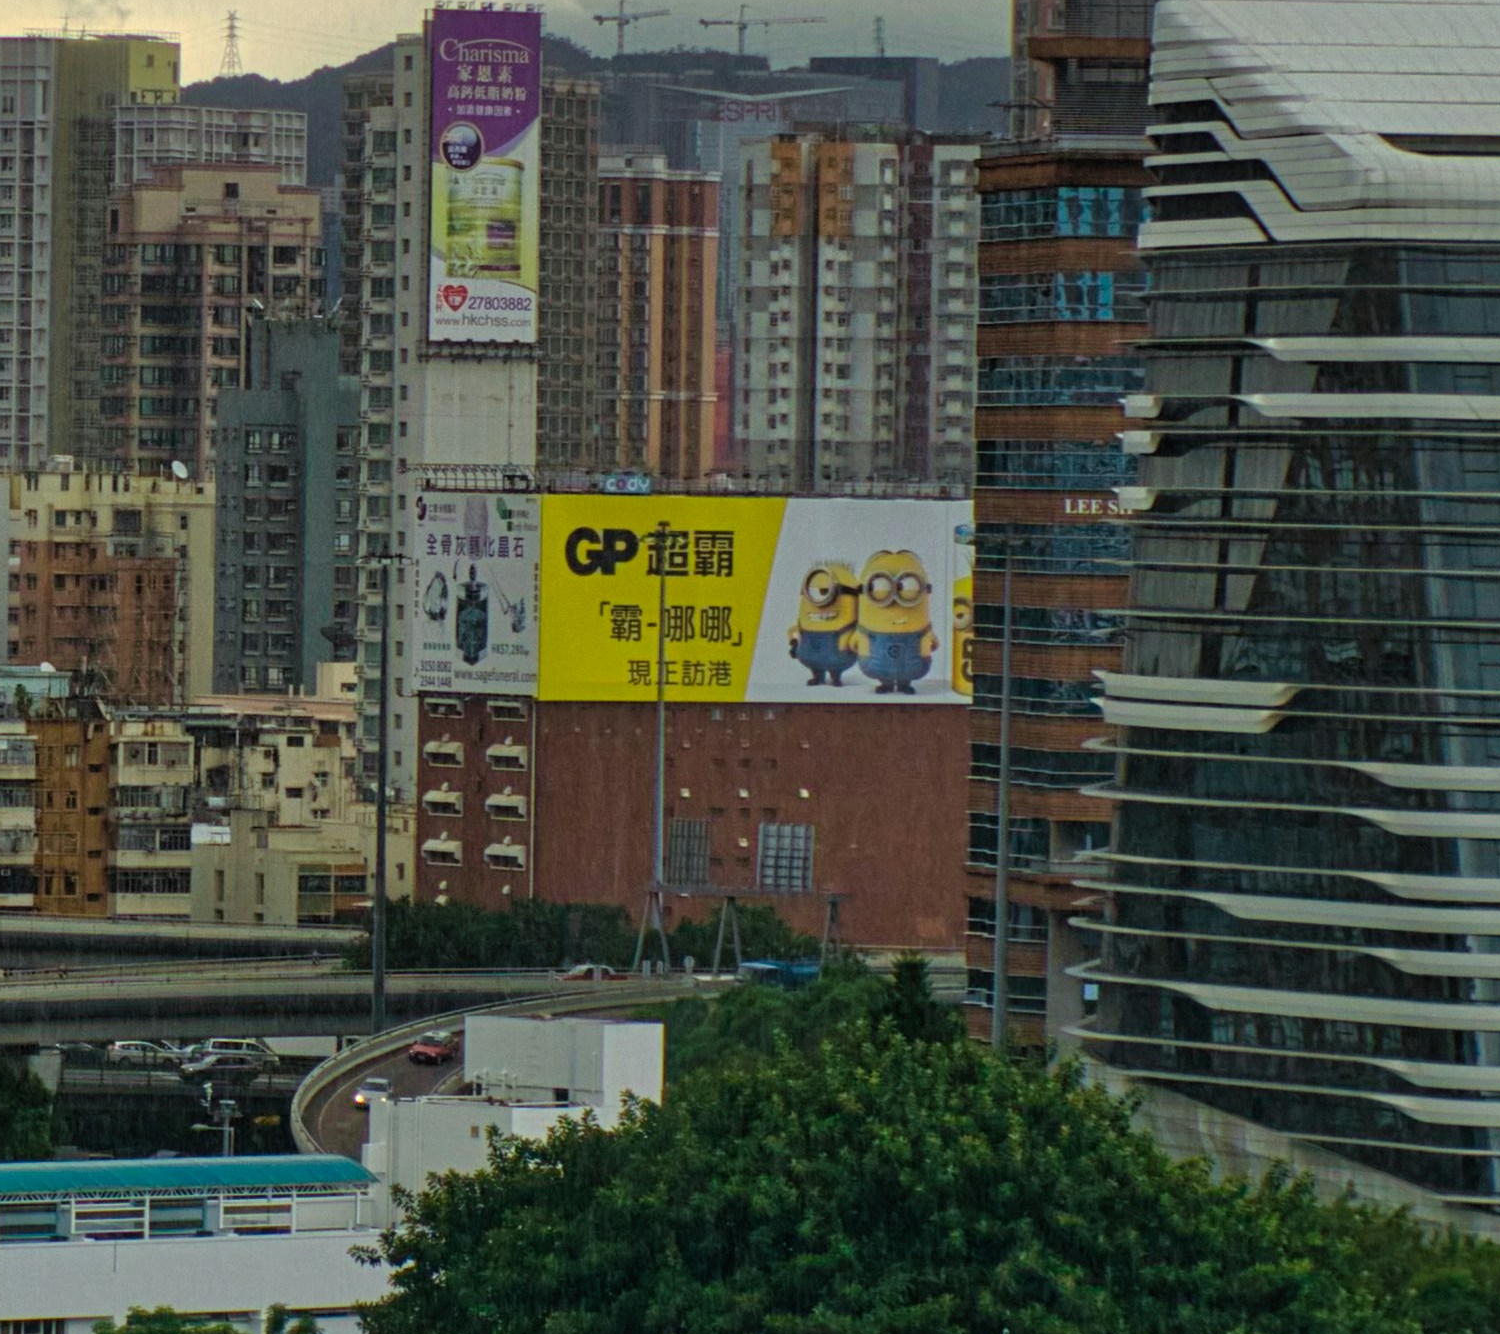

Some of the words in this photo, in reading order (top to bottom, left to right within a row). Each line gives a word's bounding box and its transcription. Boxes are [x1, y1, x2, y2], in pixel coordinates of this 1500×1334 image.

[439, 38, 530, 64] Charisma
[468, 296, 532, 311] 27803882
[435, 313, 531, 327] www.hkchss.com
[1064, 499, 1103, 515] LEE
[565, 527, 639, 576] GP
[628, 660, 732, 687] 現正訪港
